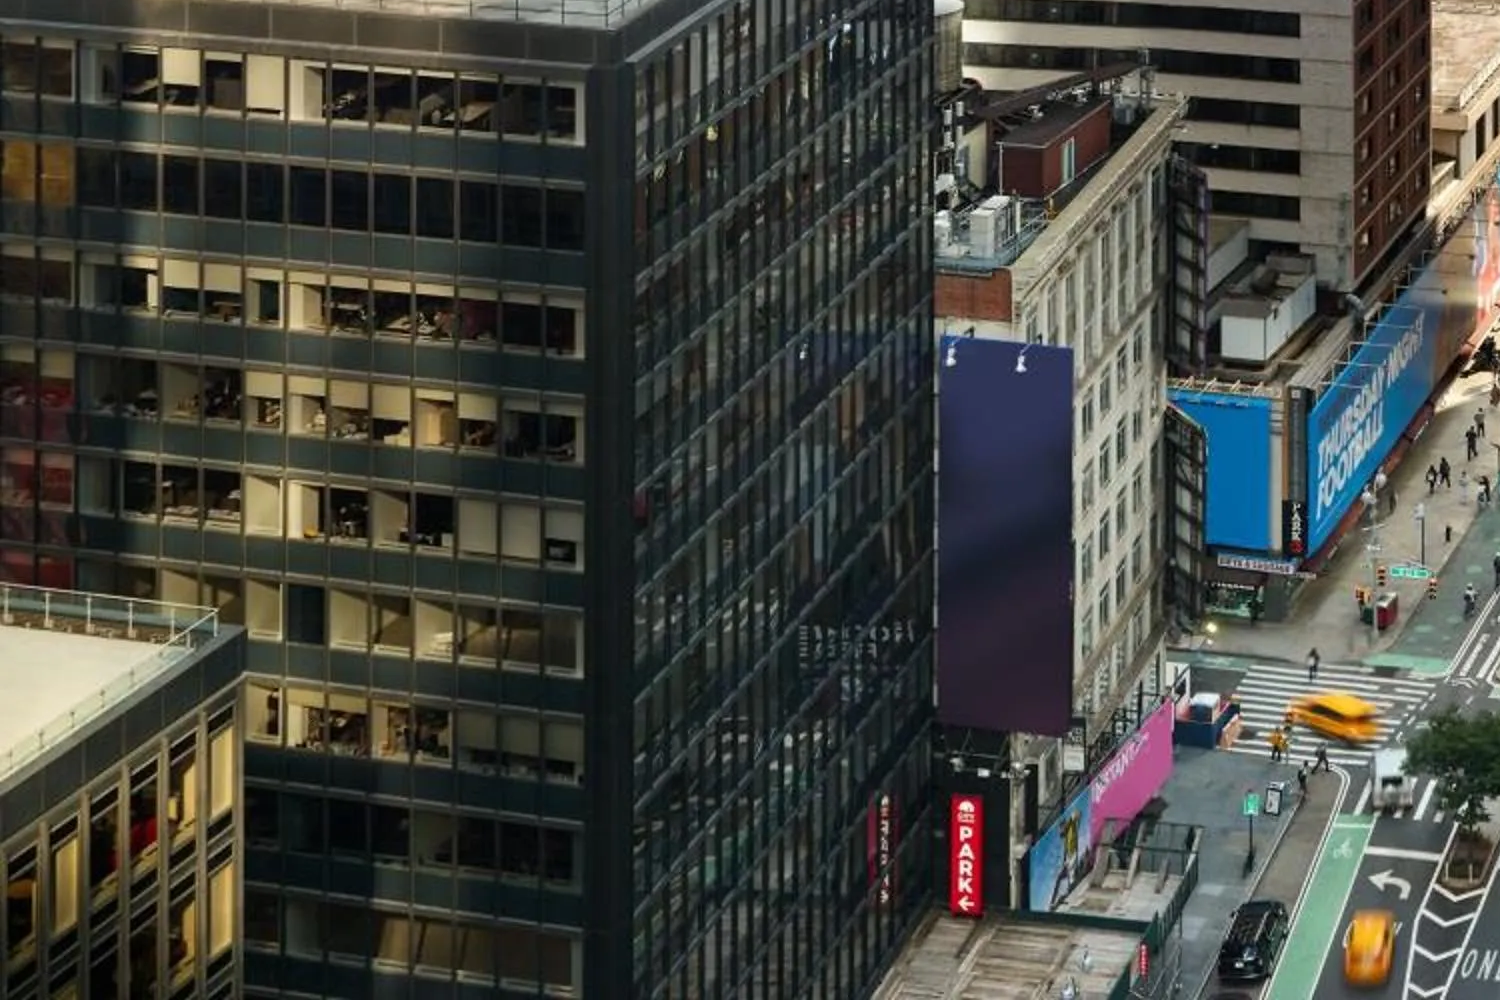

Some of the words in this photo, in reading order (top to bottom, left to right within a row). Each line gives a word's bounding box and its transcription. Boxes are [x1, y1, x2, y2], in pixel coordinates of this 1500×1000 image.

[1316, 401, 1385, 521] FOOTBALL
[1317, 359, 1387, 479] THURSDAY
[957, 826, 976, 894] PARK
